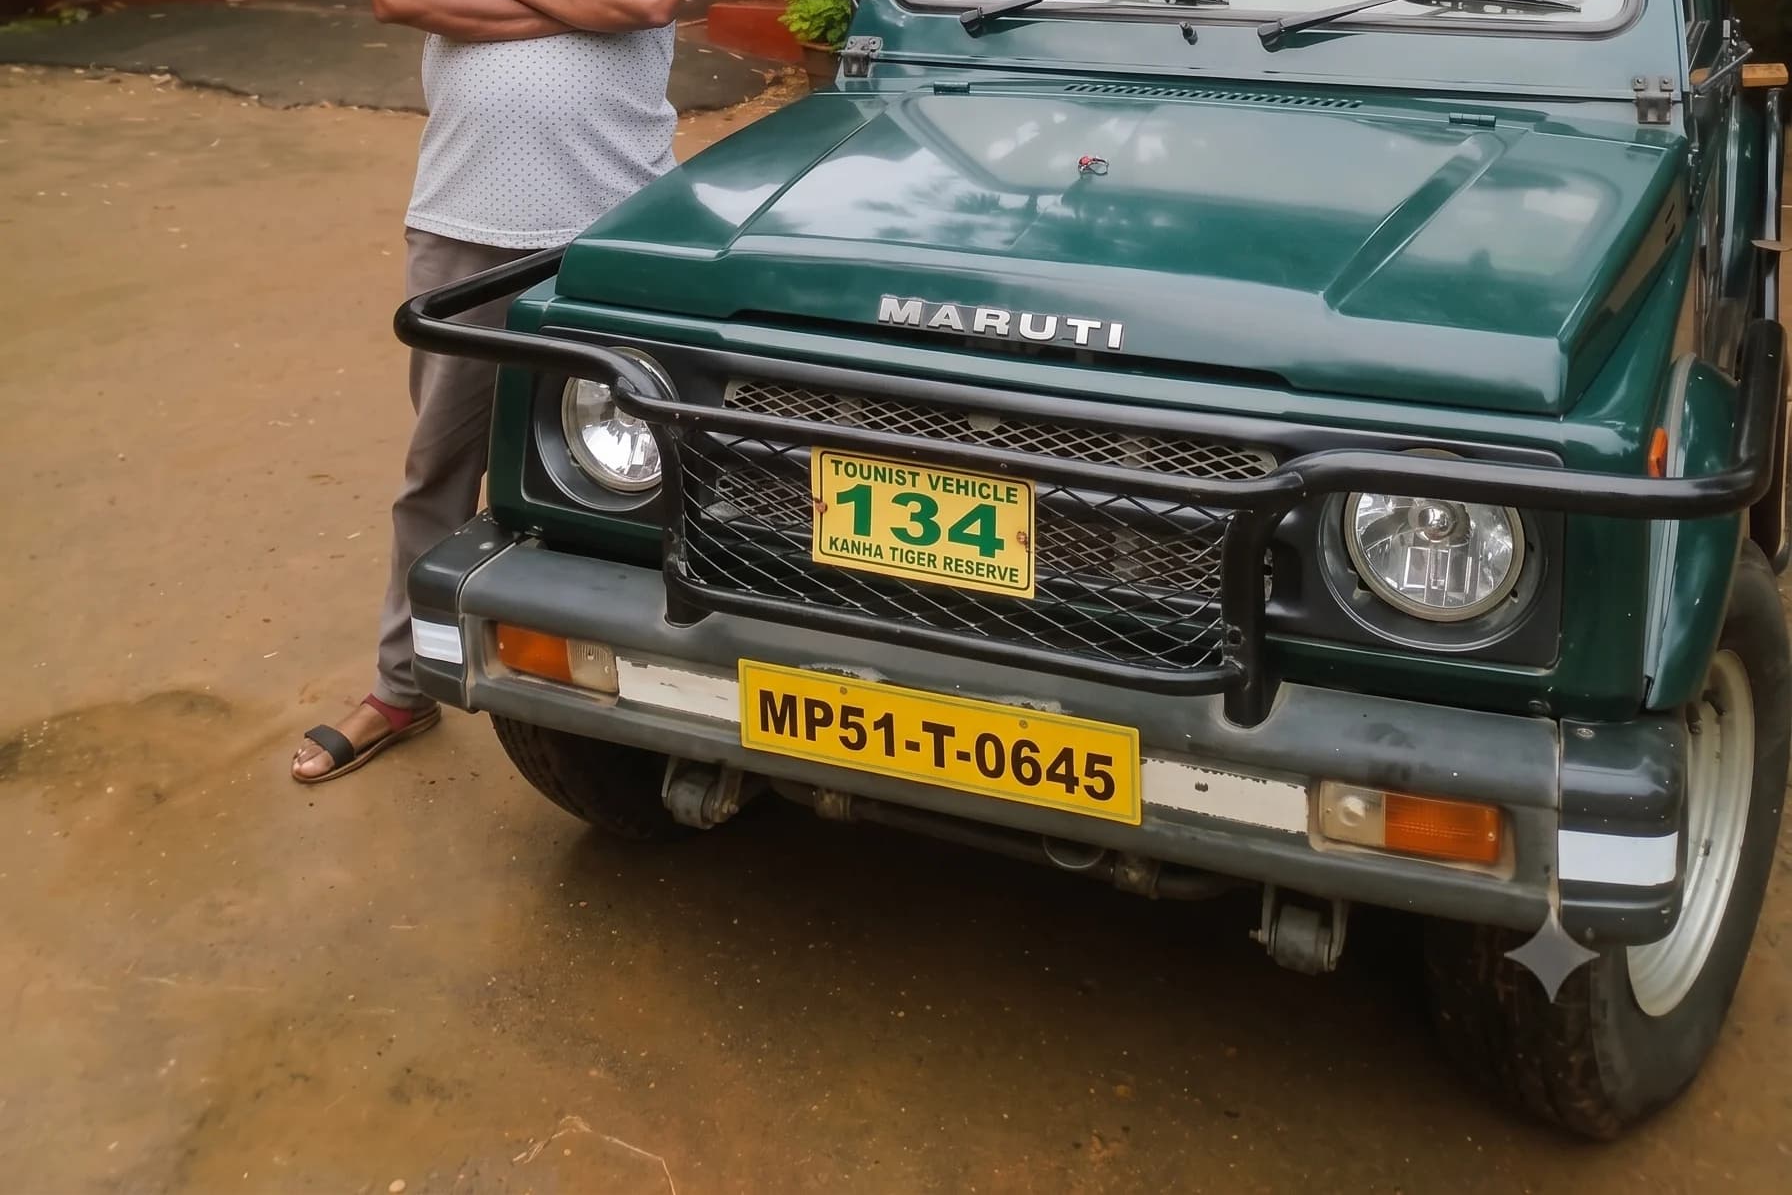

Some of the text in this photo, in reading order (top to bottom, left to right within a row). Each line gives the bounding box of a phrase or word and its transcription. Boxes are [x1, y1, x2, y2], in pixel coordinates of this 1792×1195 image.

[878, 297, 1124, 349] MARUTI
[928, 473, 1018, 505] VEHICLE
[836, 484, 1005, 559] 134
[829, 536, 1019, 583] KANHA TIGER RESERVE
[758, 689, 1116, 802] MP51-T-0645
